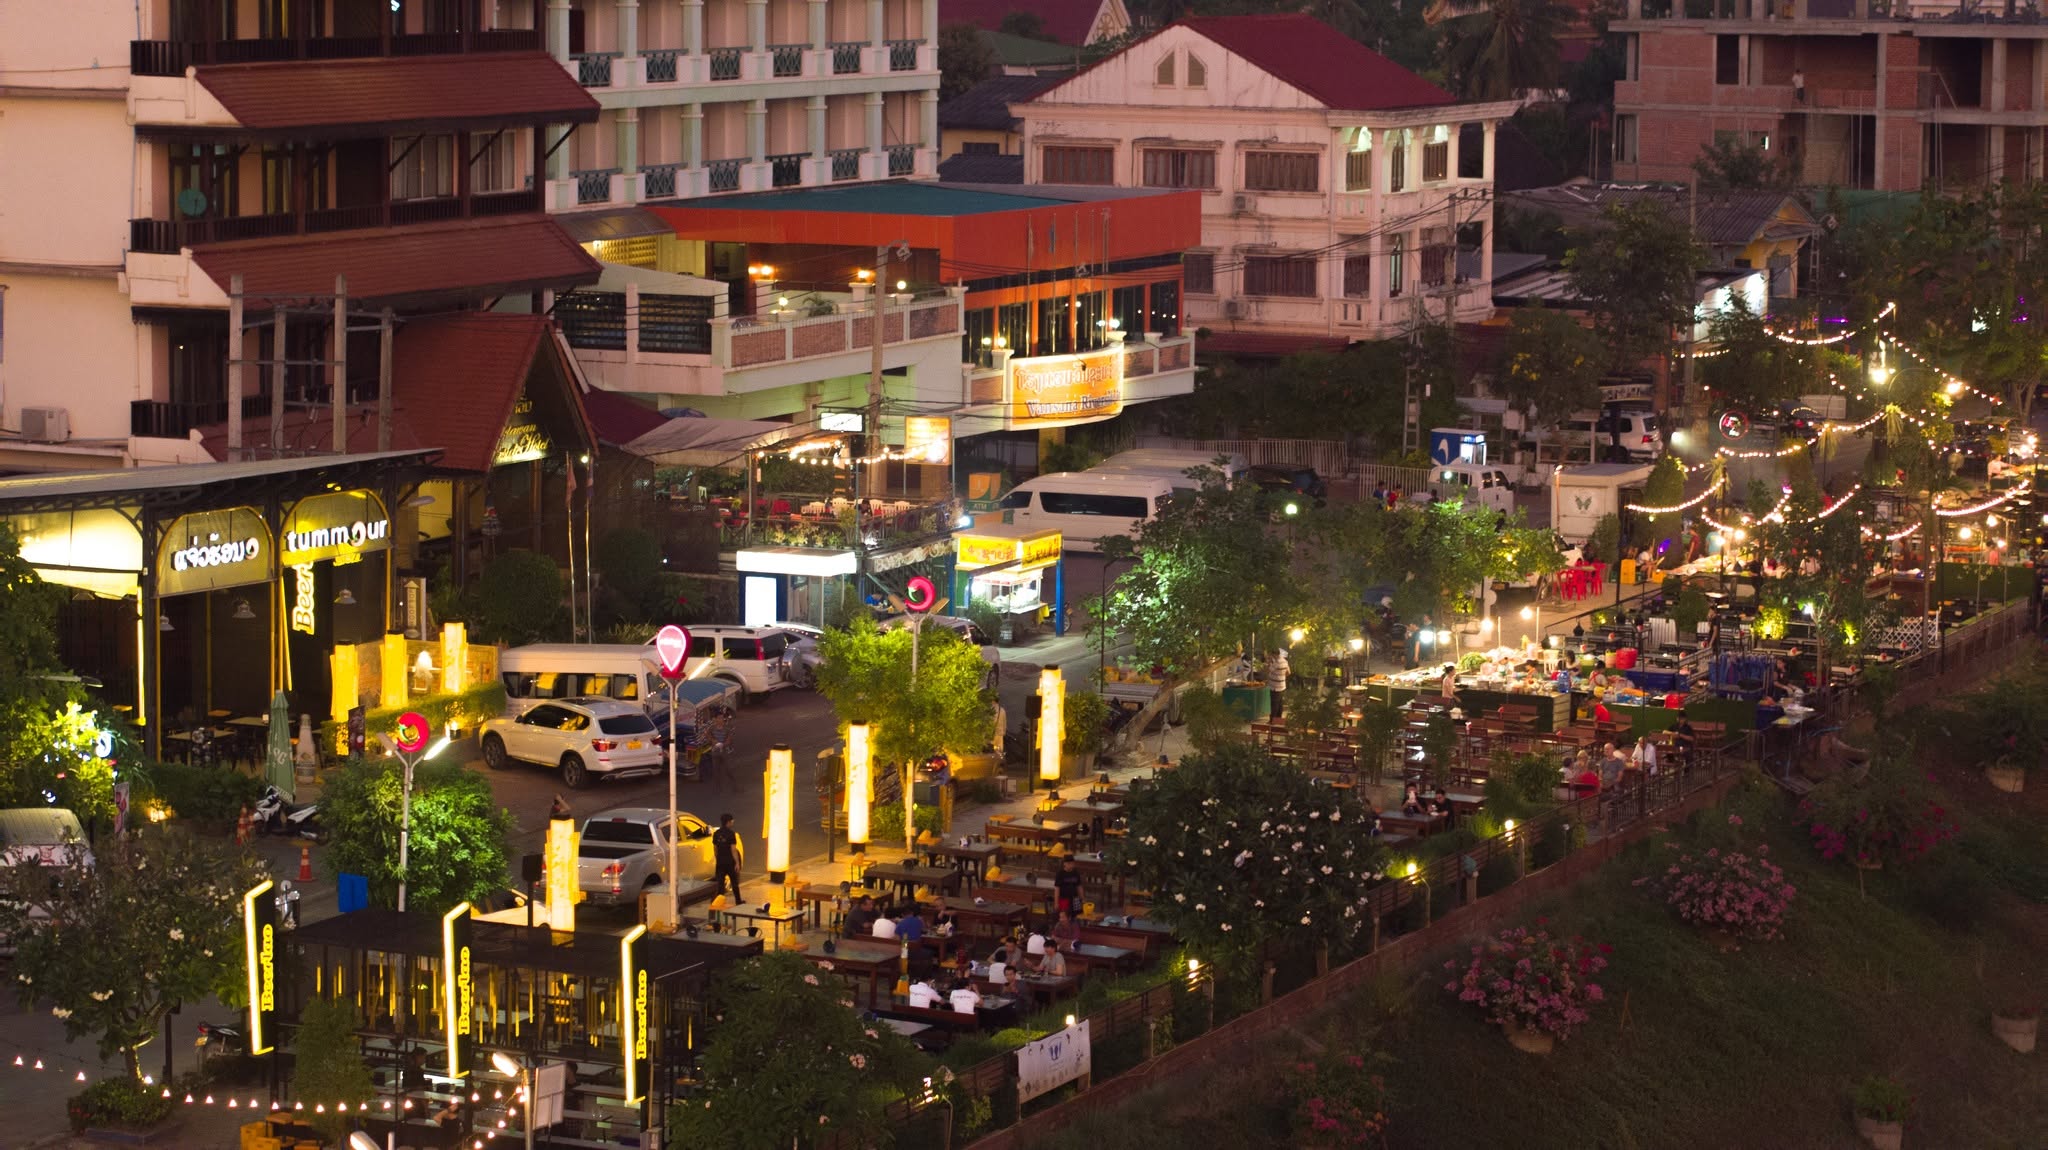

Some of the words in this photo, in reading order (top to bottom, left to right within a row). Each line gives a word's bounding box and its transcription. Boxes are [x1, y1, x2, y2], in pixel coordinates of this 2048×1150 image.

[287, 519, 388, 552] tummour
[972, 502, 988, 511] ATM
[292, 561, 315, 635] Beer
[261, 924, 274, 1011] Beerlao
[458, 946, 470, 1035] Beerlao
[636, 969, 647, 1059] Beerlao
